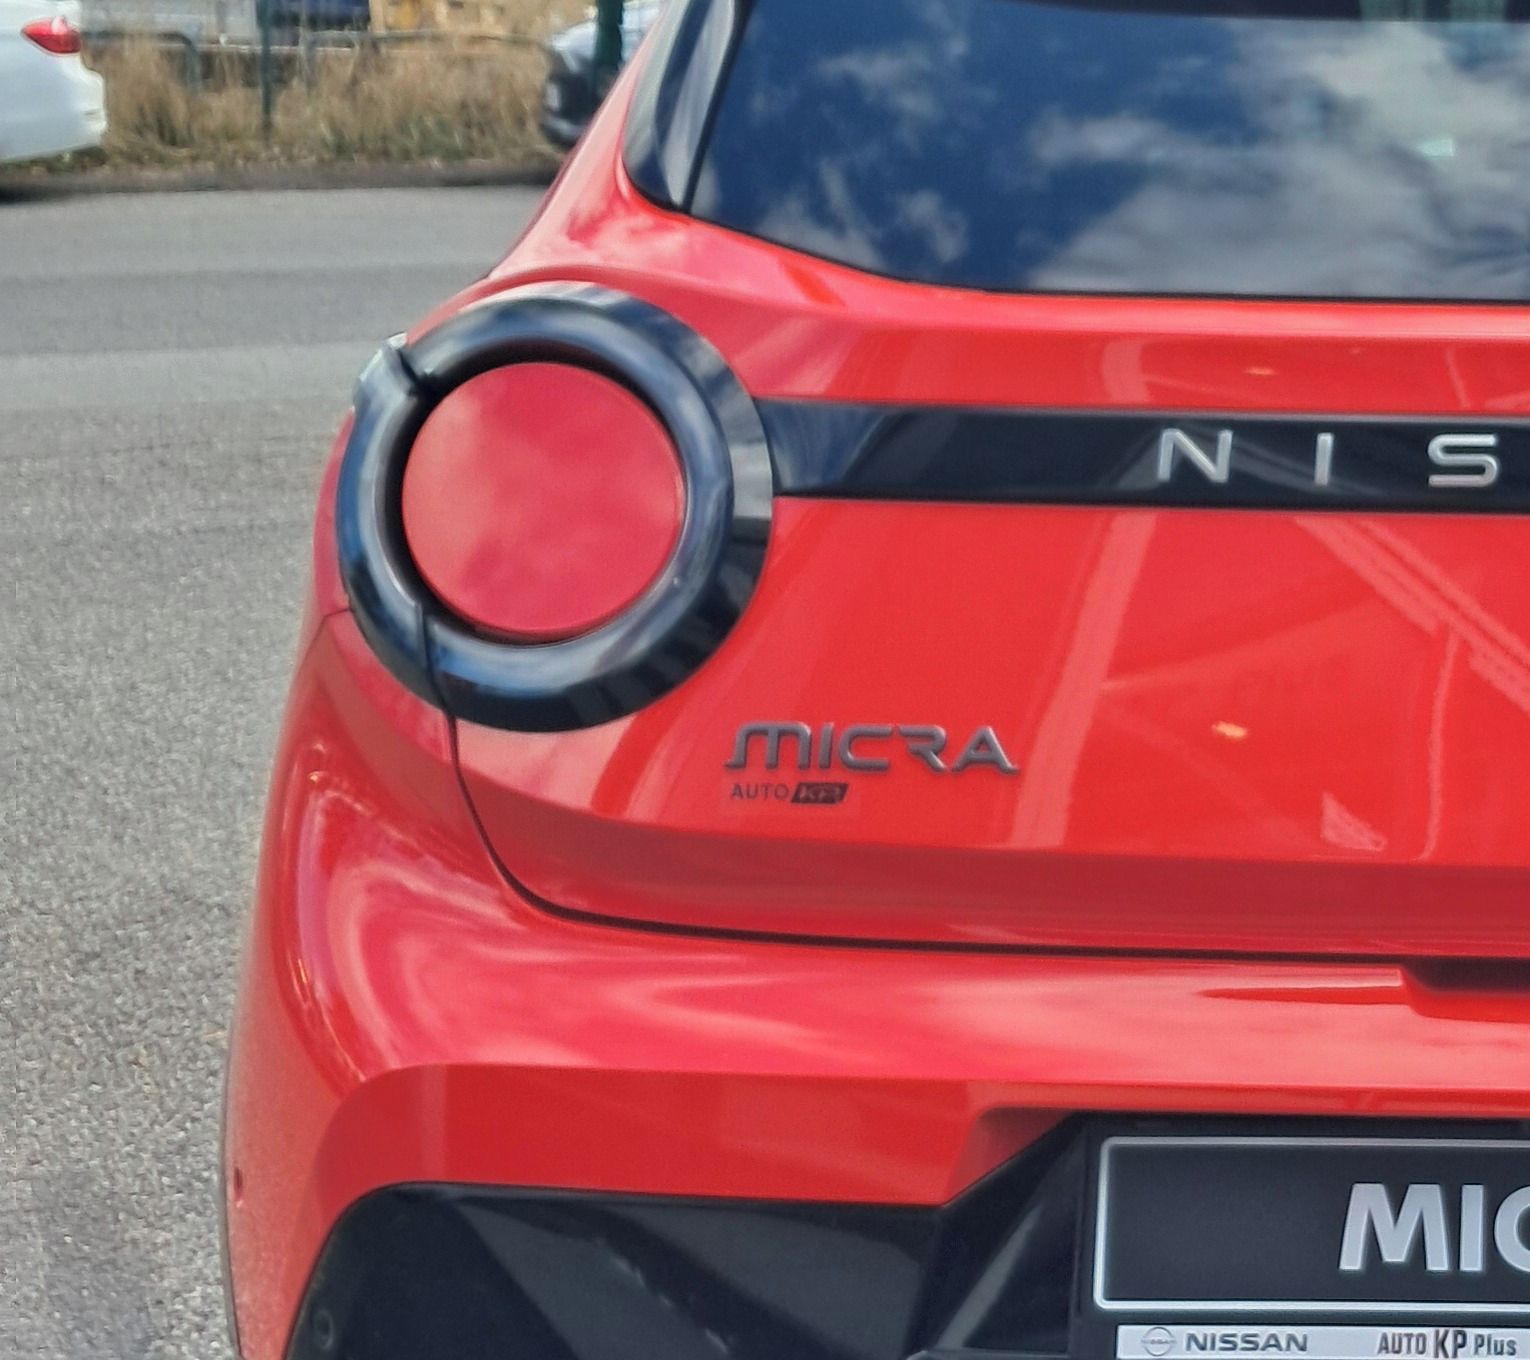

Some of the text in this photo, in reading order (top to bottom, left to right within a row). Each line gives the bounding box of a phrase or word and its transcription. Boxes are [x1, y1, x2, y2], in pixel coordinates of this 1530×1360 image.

[723, 721, 1020, 774] MICRA
[731, 782, 790, 801] AUTO
[1184, 1331, 1309, 1353] NISSAN
[1376, 1331, 1428, 1356] AUTO
[1431, 1328, 1468, 1360] KP
[1473, 1332, 1518, 1357] Plus
